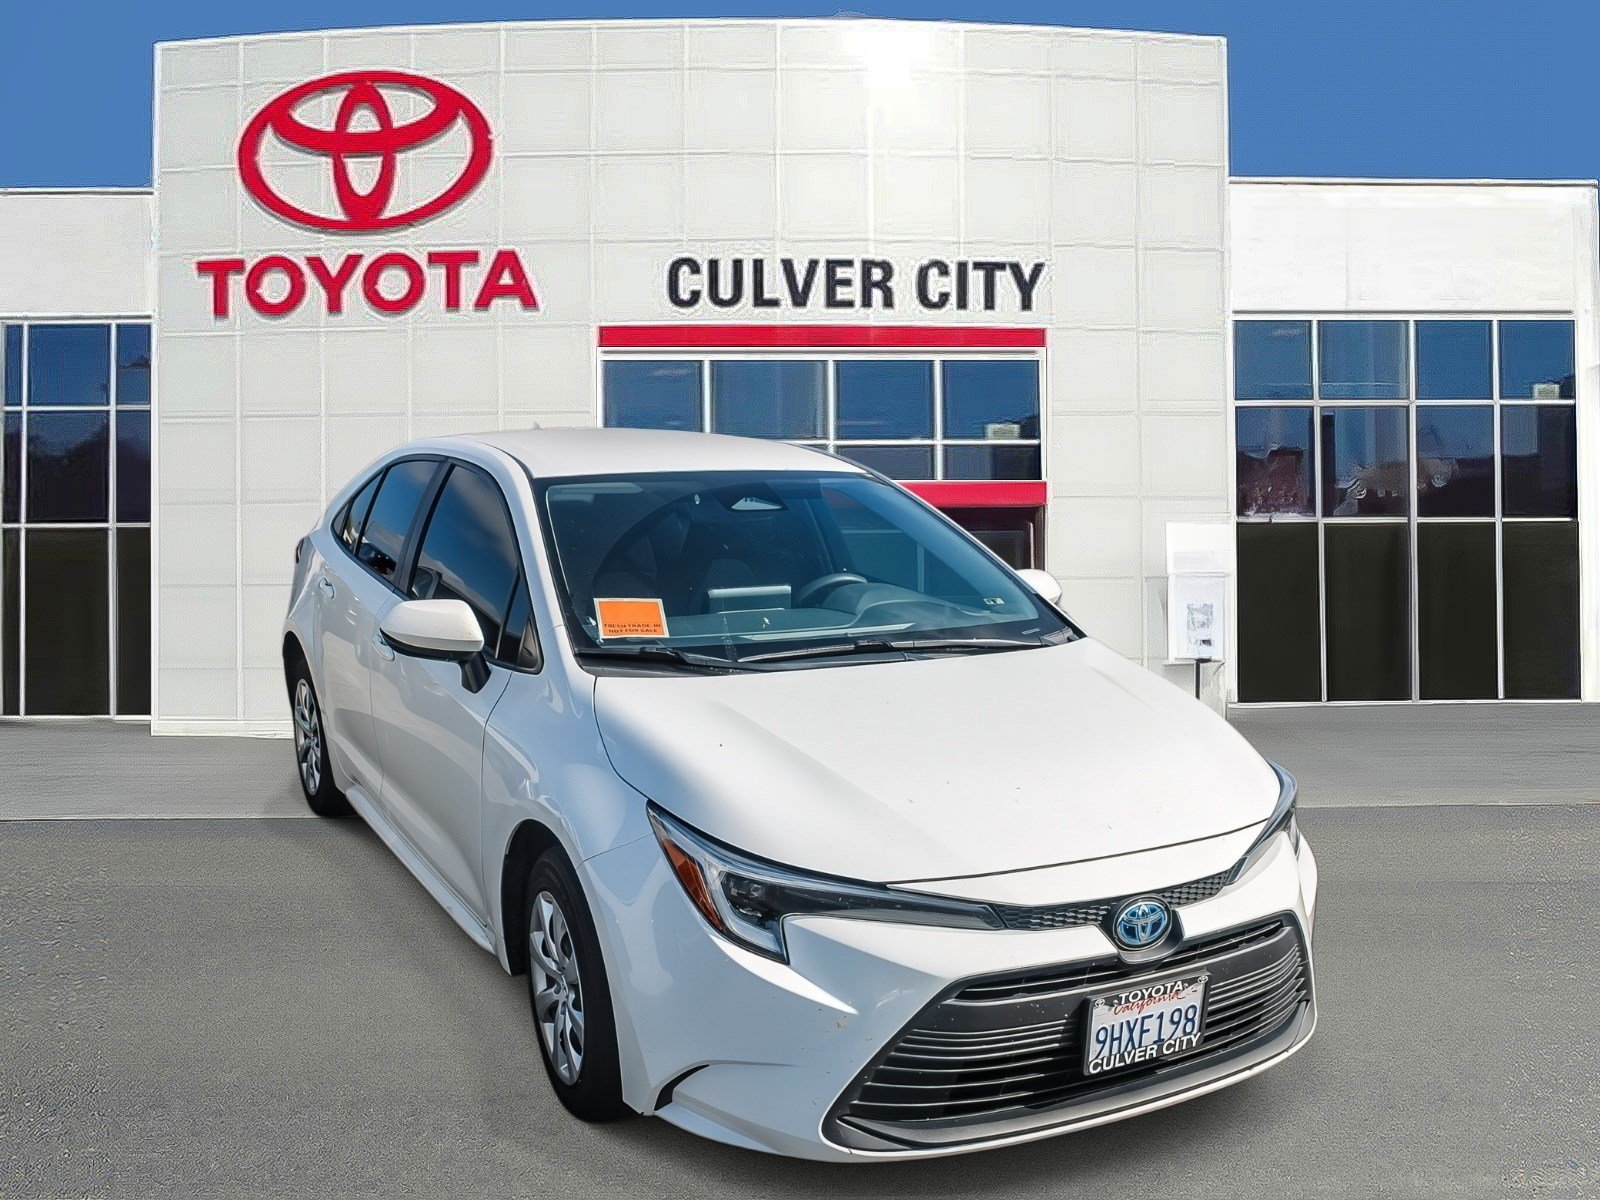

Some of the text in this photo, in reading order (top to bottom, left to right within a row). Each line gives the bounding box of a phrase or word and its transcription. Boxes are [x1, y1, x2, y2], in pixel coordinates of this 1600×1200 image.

[195, 249, 539, 318] TOYOTA
[667, 257, 1046, 311] CULVER CITY
[1114, 990, 1186, 1015] California
[1118, 980, 1184, 1004] TOYOTA
[1089, 1032, 1202, 1074] CULVER CITY
[1095, 1005, 1198, 1059] 9HXF198
